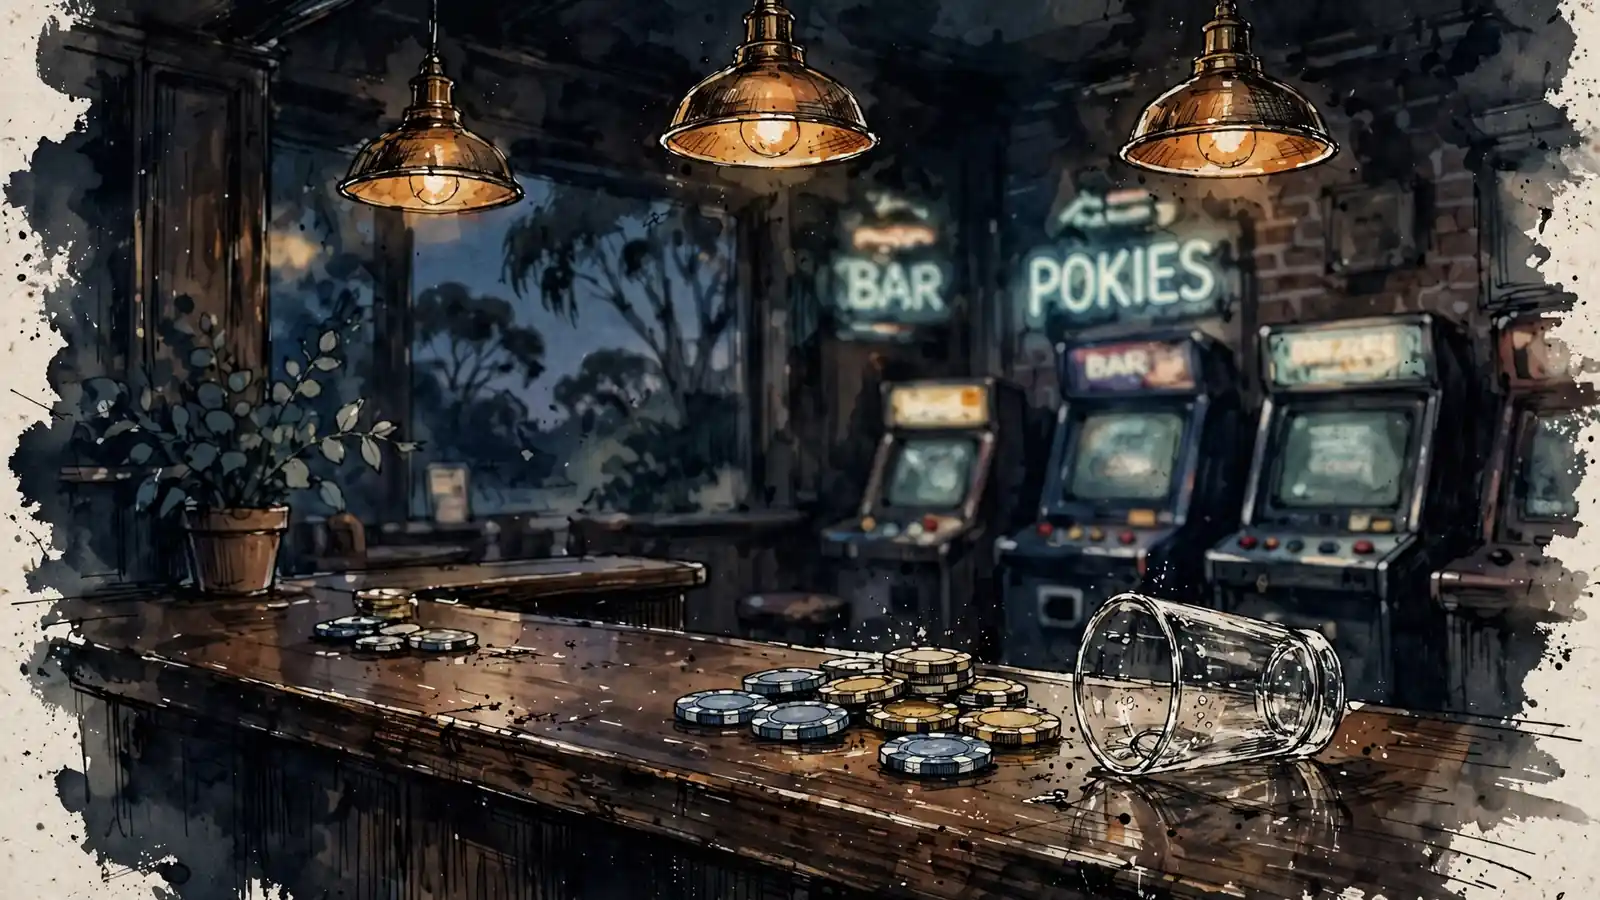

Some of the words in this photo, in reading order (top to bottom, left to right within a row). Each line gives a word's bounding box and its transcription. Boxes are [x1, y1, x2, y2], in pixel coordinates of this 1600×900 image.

[843, 259, 943, 311] BAR
[1028, 240, 1215, 316] POKIES
[1086, 350, 1149, 381] BAR
